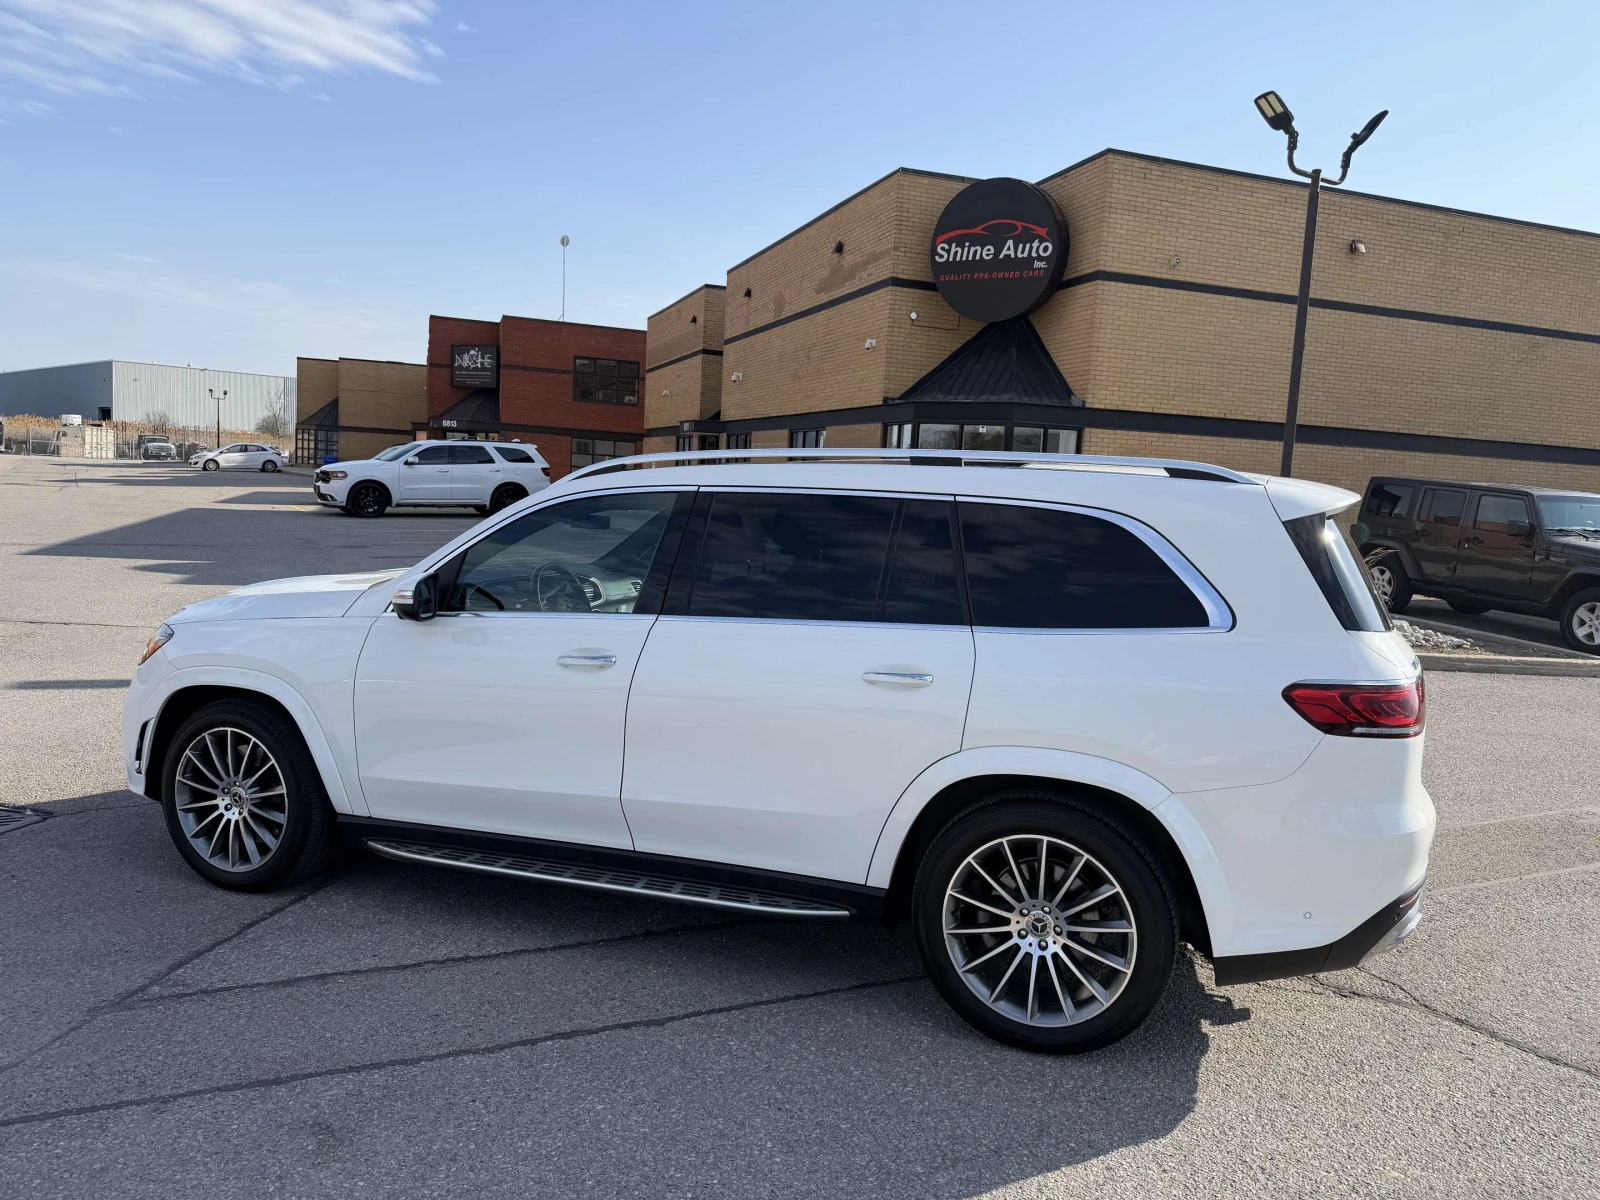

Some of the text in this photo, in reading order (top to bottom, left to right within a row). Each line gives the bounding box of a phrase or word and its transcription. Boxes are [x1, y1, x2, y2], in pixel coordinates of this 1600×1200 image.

[935, 239, 1053, 263] Shine Auto
[1033, 260, 1048, 269] Inc.
[973, 271, 1020, 279] PRE-OWNED
[442, 420, 457, 428] 6813
